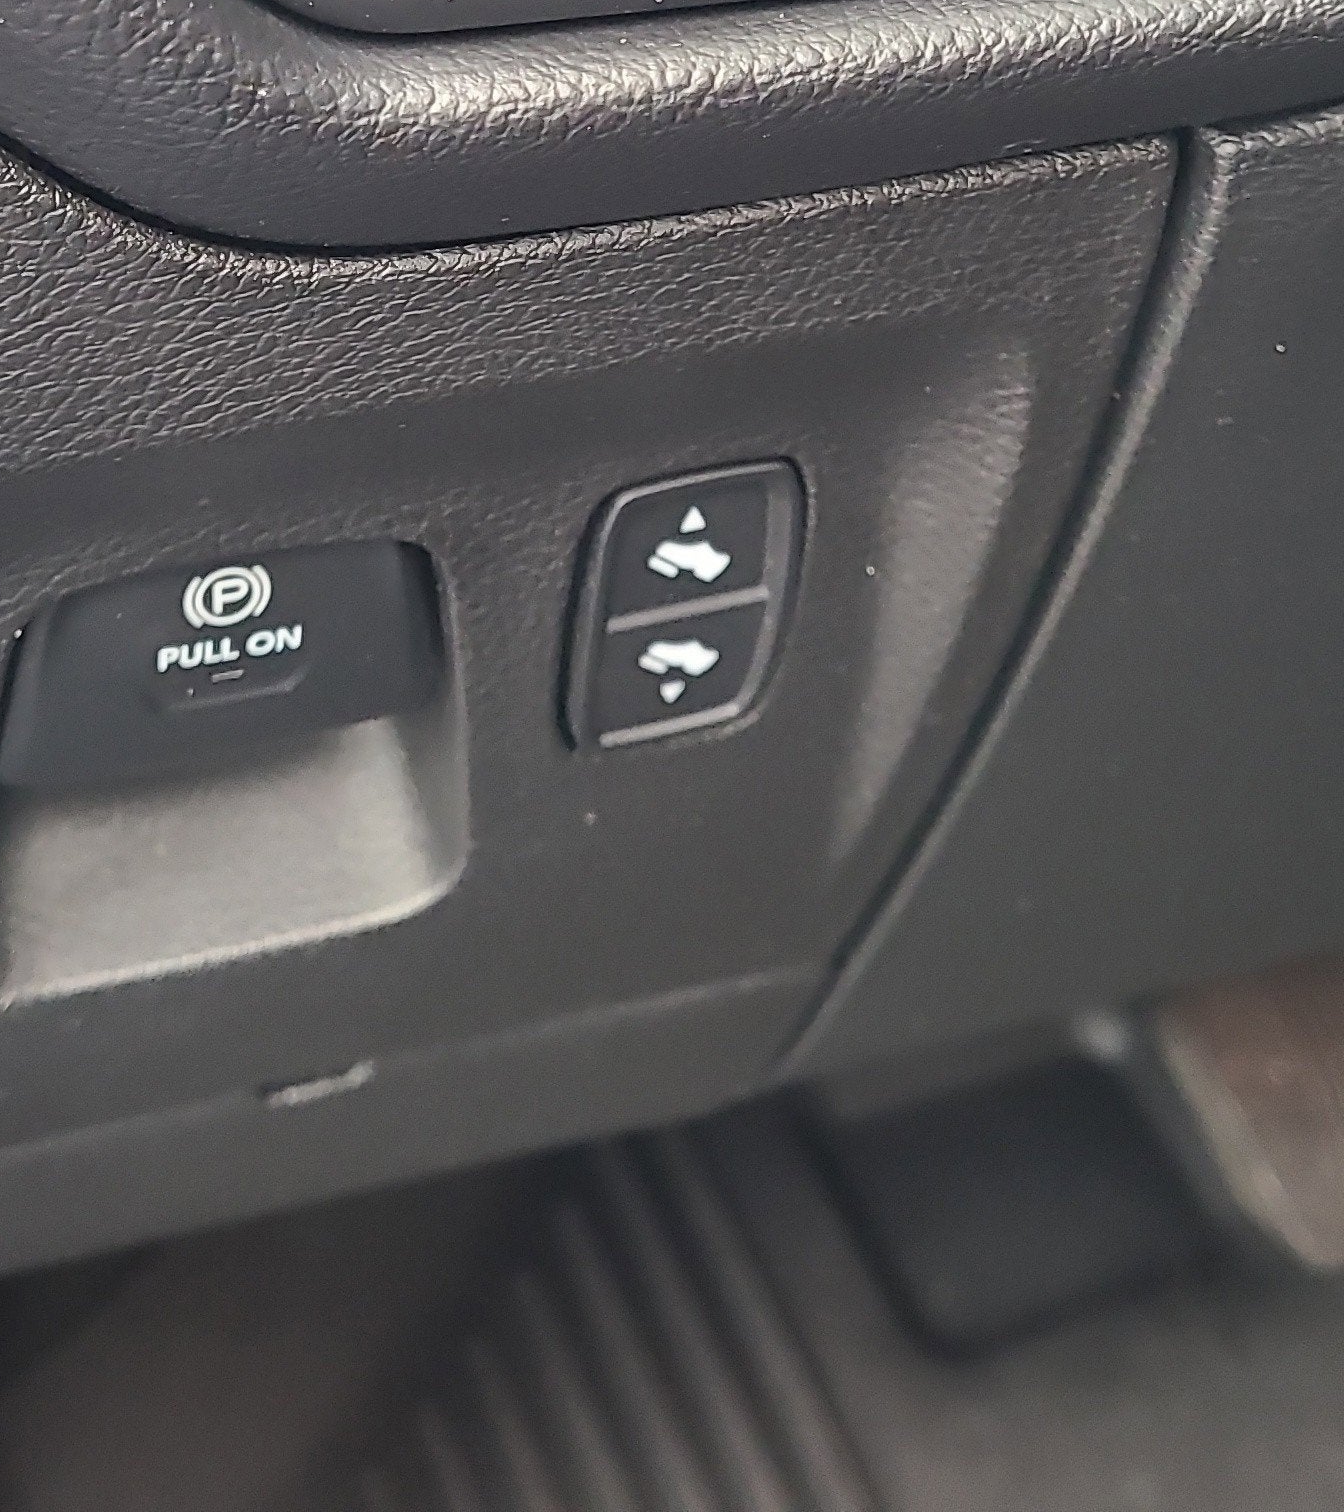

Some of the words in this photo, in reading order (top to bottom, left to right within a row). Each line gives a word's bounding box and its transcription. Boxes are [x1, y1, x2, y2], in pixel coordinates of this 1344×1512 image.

[211, 577, 249, 615] P
[156, 636, 241, 673] PULL
[244, 624, 303, 657] ON
